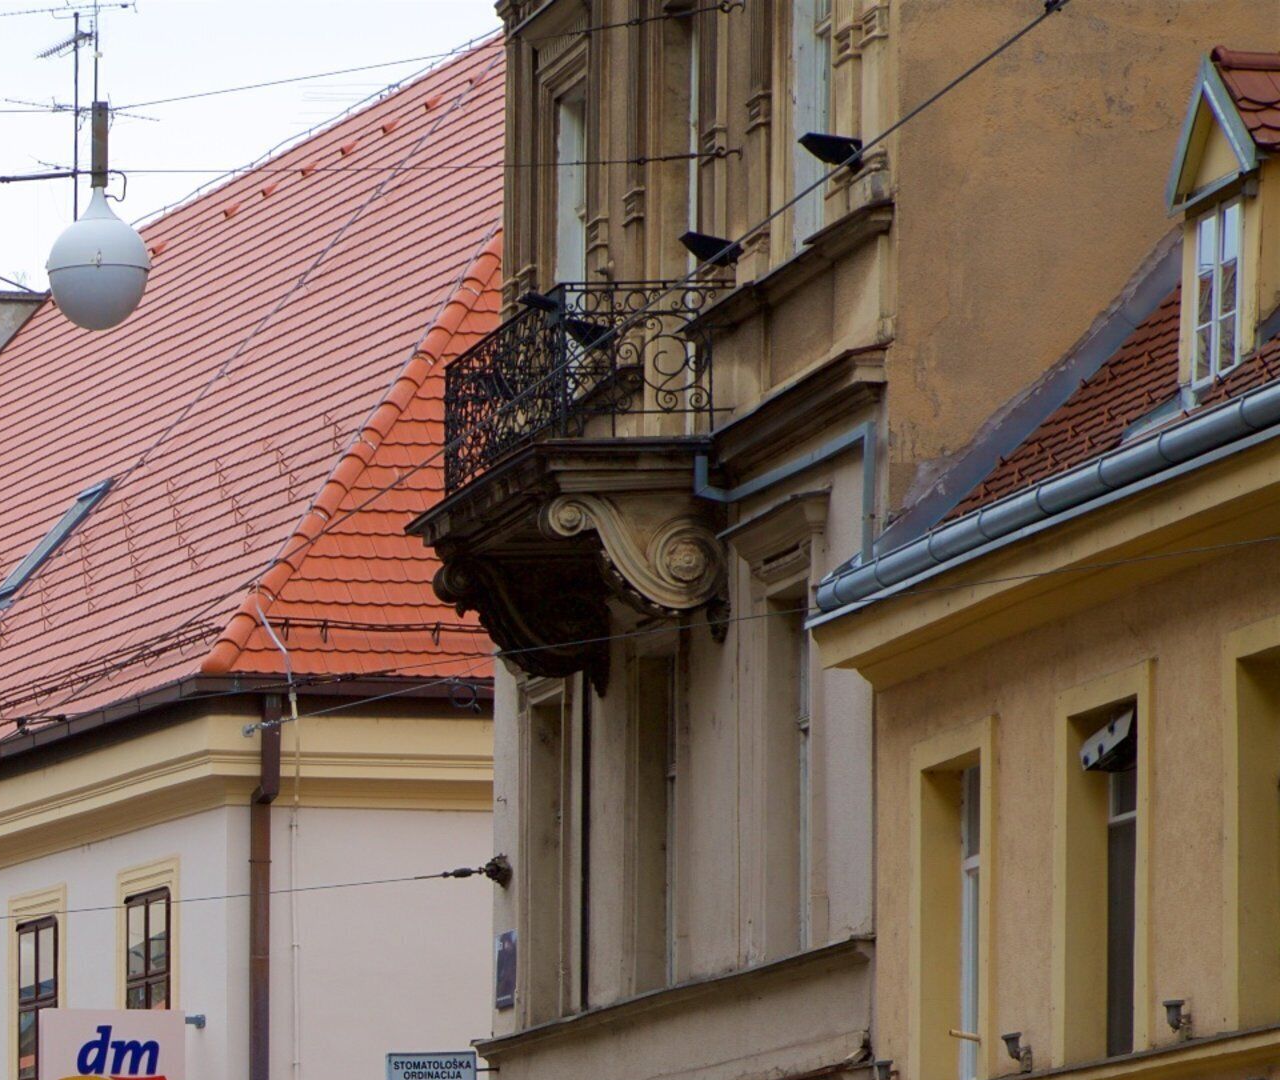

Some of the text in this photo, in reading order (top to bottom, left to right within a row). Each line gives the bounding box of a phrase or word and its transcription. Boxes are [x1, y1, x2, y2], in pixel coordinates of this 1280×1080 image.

[77, 1025, 160, 1075] dm
[393, 1057, 472, 1070] STOMATOLOŠKA
[403, 1070, 462, 1080] ORDINACIJA
